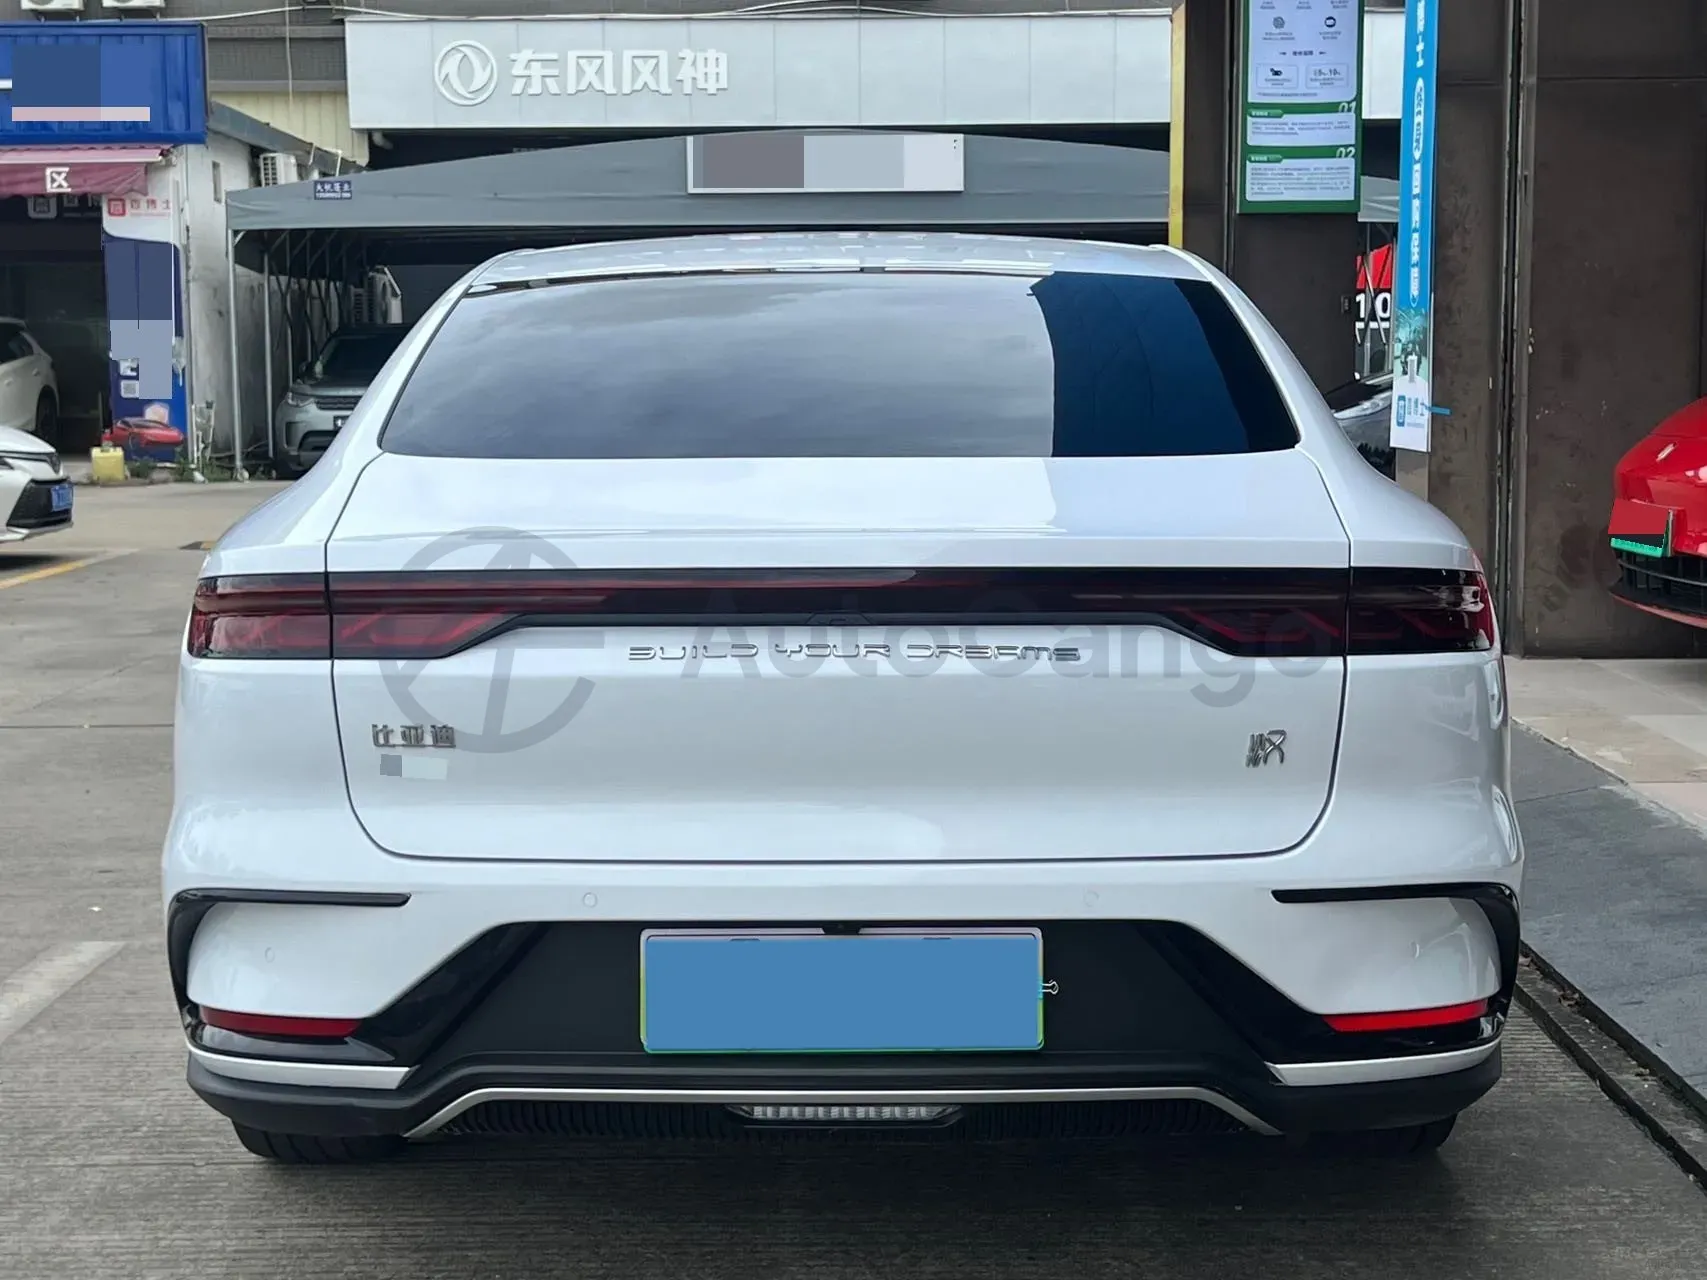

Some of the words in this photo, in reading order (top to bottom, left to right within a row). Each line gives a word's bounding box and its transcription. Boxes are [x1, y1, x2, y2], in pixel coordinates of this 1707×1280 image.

[510, 49, 727, 95] 东风风神
[628, 644, 758, 661] BUILD
[774, 642, 891, 659] YOUR
[906, 643, 1081, 662] DREAMS
[371, 723, 457, 749] 比亚迪
